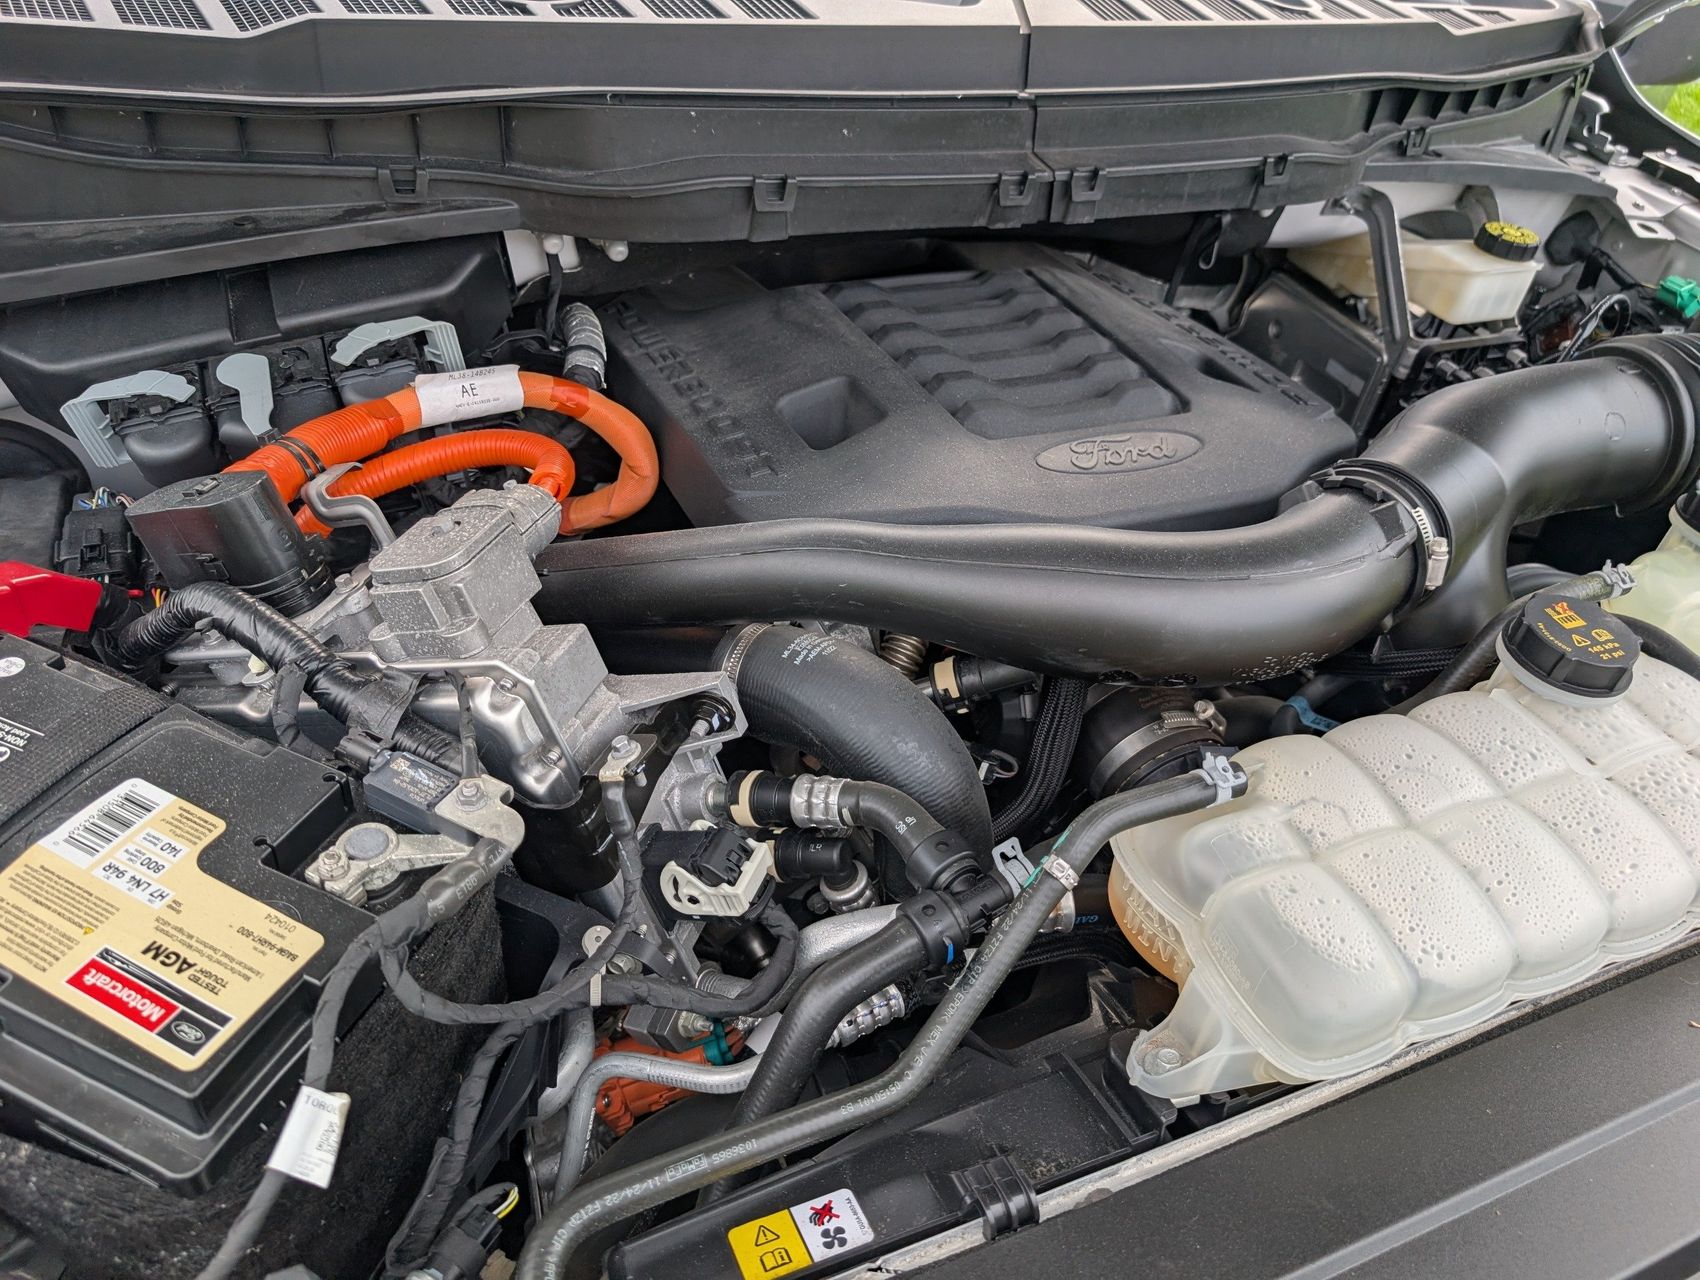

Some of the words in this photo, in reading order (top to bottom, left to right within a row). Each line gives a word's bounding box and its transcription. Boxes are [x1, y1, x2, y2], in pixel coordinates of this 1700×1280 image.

[460, 382, 478, 398] AE
[1069, 435, 1177, 469] Ford
[1587, 644, 1603, 653] 145
[1599, 651, 1612, 660] 21
[893, 819, 908, 834] ISC
[157, 841, 184, 857] 140
[100, 861, 130, 879] 94R
[137, 855, 167, 874] 800
[124, 873, 153, 891] LN4
[148, 886, 171, 901] H7
[262, 911, 299, 933] 010424
[138, 939, 198, 975] AGM
[83, 968, 166, 1018] Motorcraft
[185, 973, 223, 995] TESTED
[170, 1022, 205, 1043] Ford
[709, 1137, 758, 1164] 1036865
[604, 1176, 661, 1207] 11/24/22
